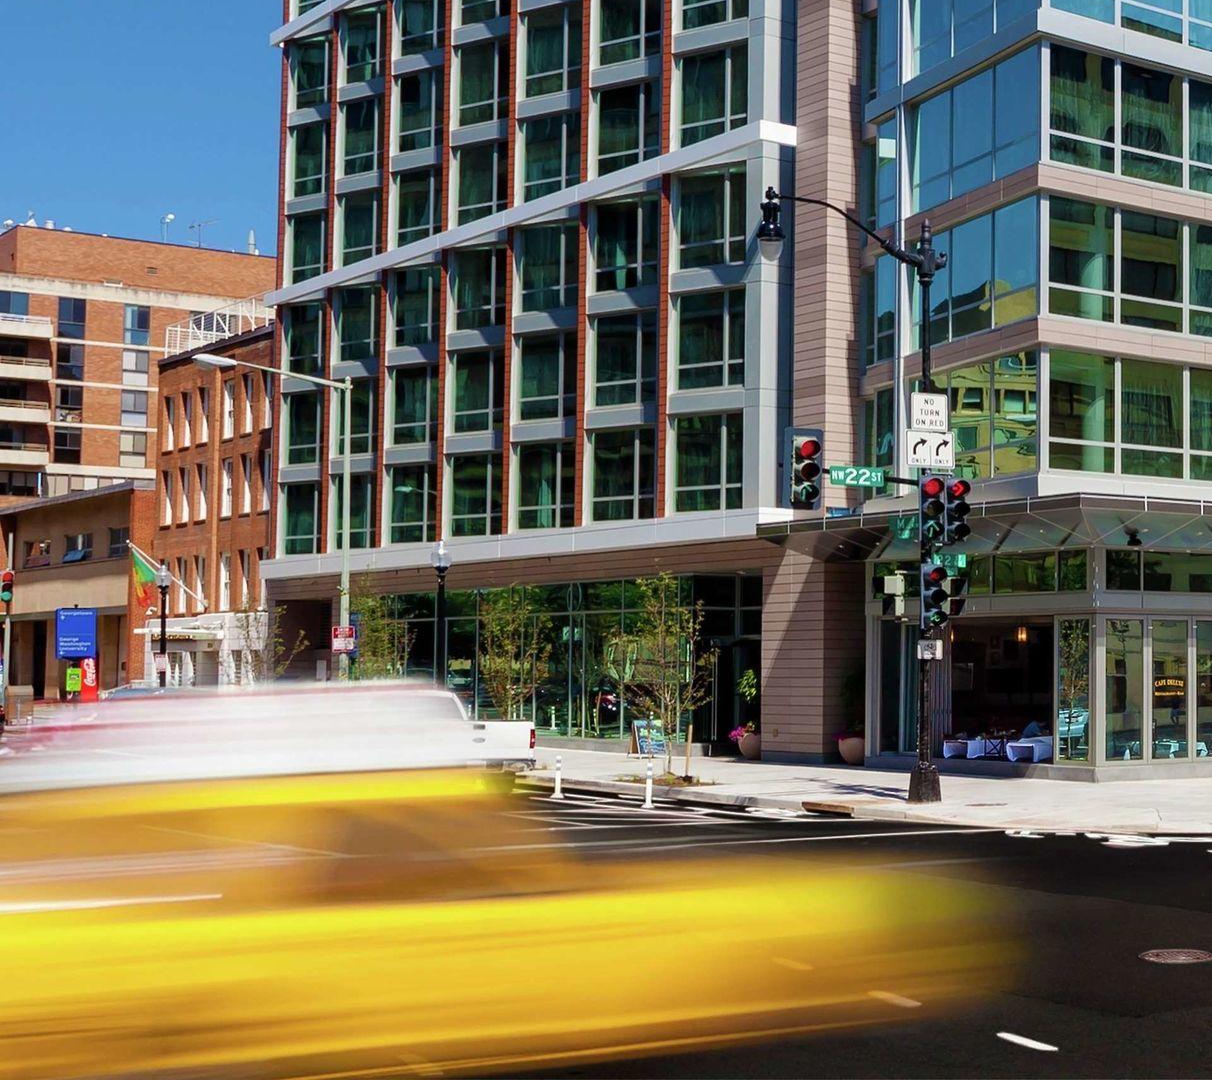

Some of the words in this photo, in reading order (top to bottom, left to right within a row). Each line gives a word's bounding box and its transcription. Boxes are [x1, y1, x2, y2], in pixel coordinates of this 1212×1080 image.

[923, 398, 935, 406] NO
[919, 408, 940, 417] TURN
[915, 418, 926, 426] ON
[929, 419, 944, 428] RED
[934, 457, 950, 465] ONLY
[831, 470, 845, 481] NW
[845, 468, 871, 486] 22
[871, 472, 882, 483] ST
